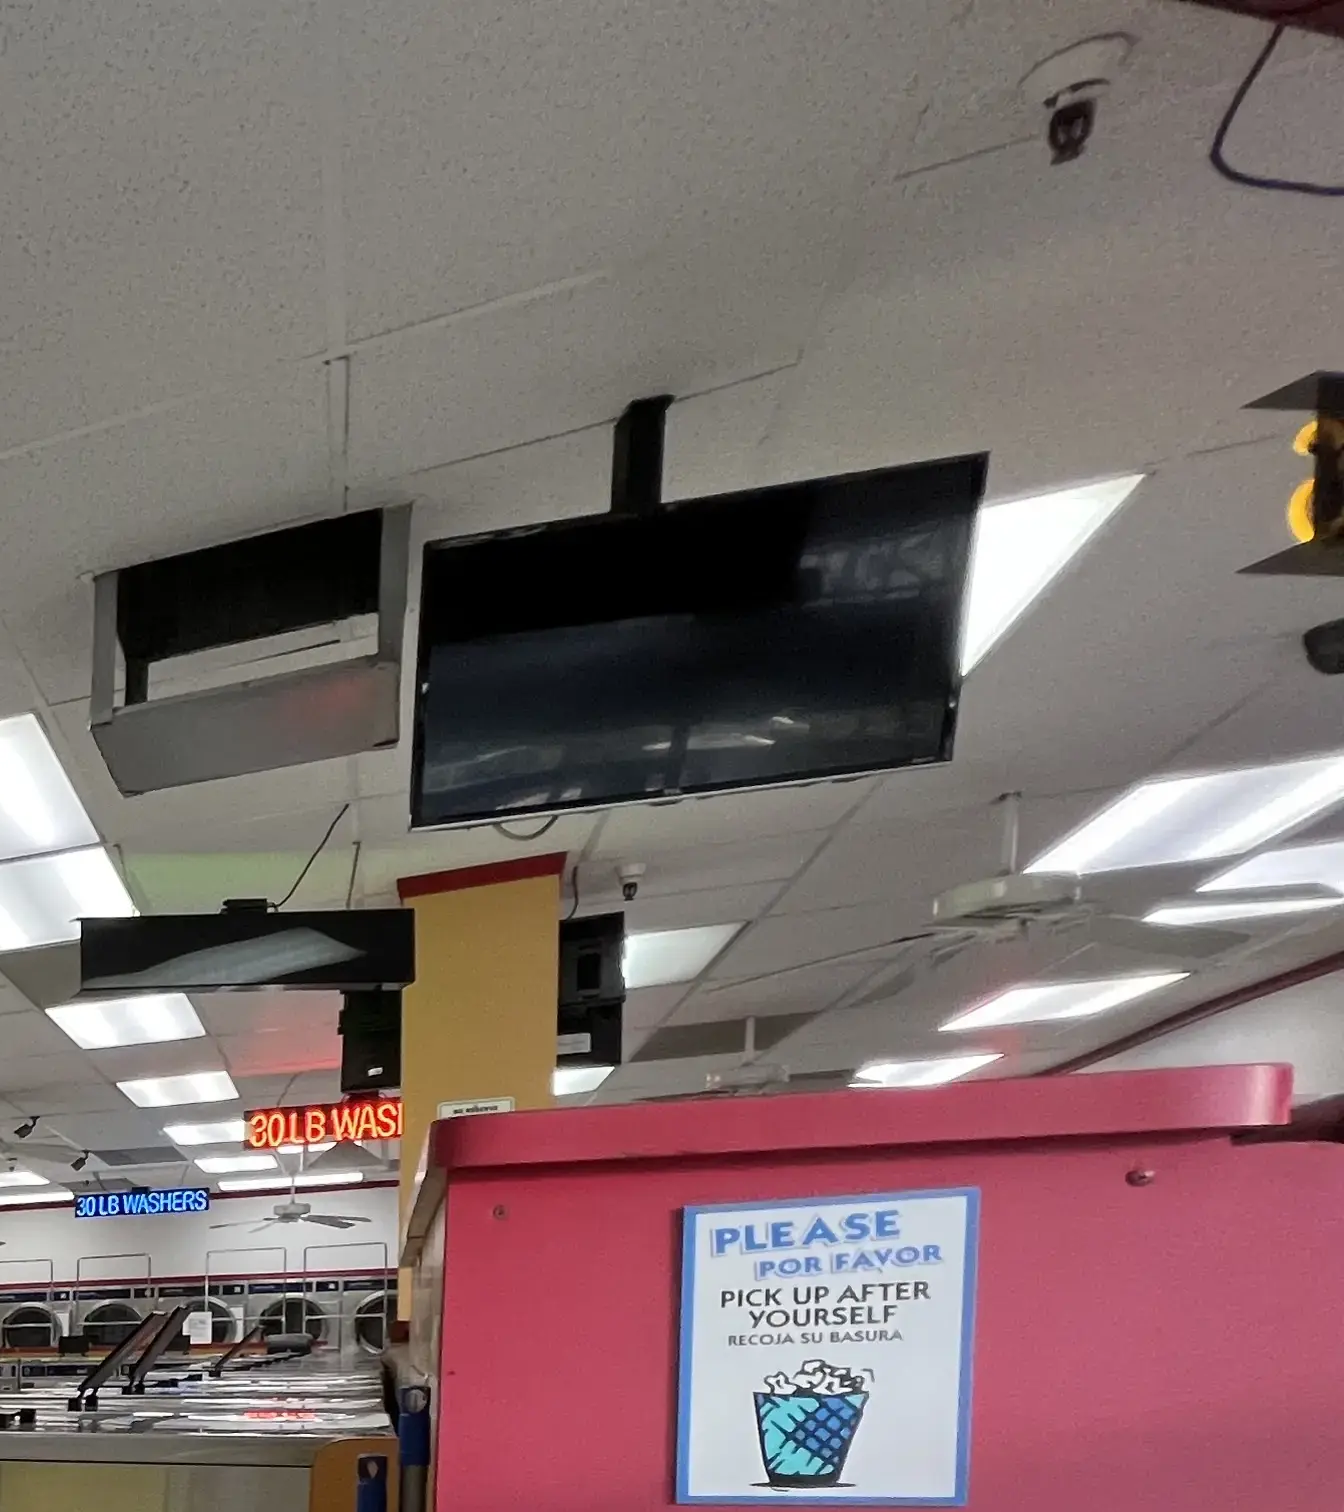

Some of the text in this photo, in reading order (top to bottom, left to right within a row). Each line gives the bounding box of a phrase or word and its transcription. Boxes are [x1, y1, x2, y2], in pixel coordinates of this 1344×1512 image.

[249, 1102, 403, 1148] 30 LB WAS
[76, 1190, 207, 1217] 30 LB WASHERS
[713, 1209, 901, 1256] PLEASE
[757, 1244, 943, 1279] POR FAVOR
[720, 1281, 931, 1308] PICK UP AFTER
[748, 1304, 898, 1329] YOURSELF
[728, 1328, 904, 1347] RECOJA SU BASURA
